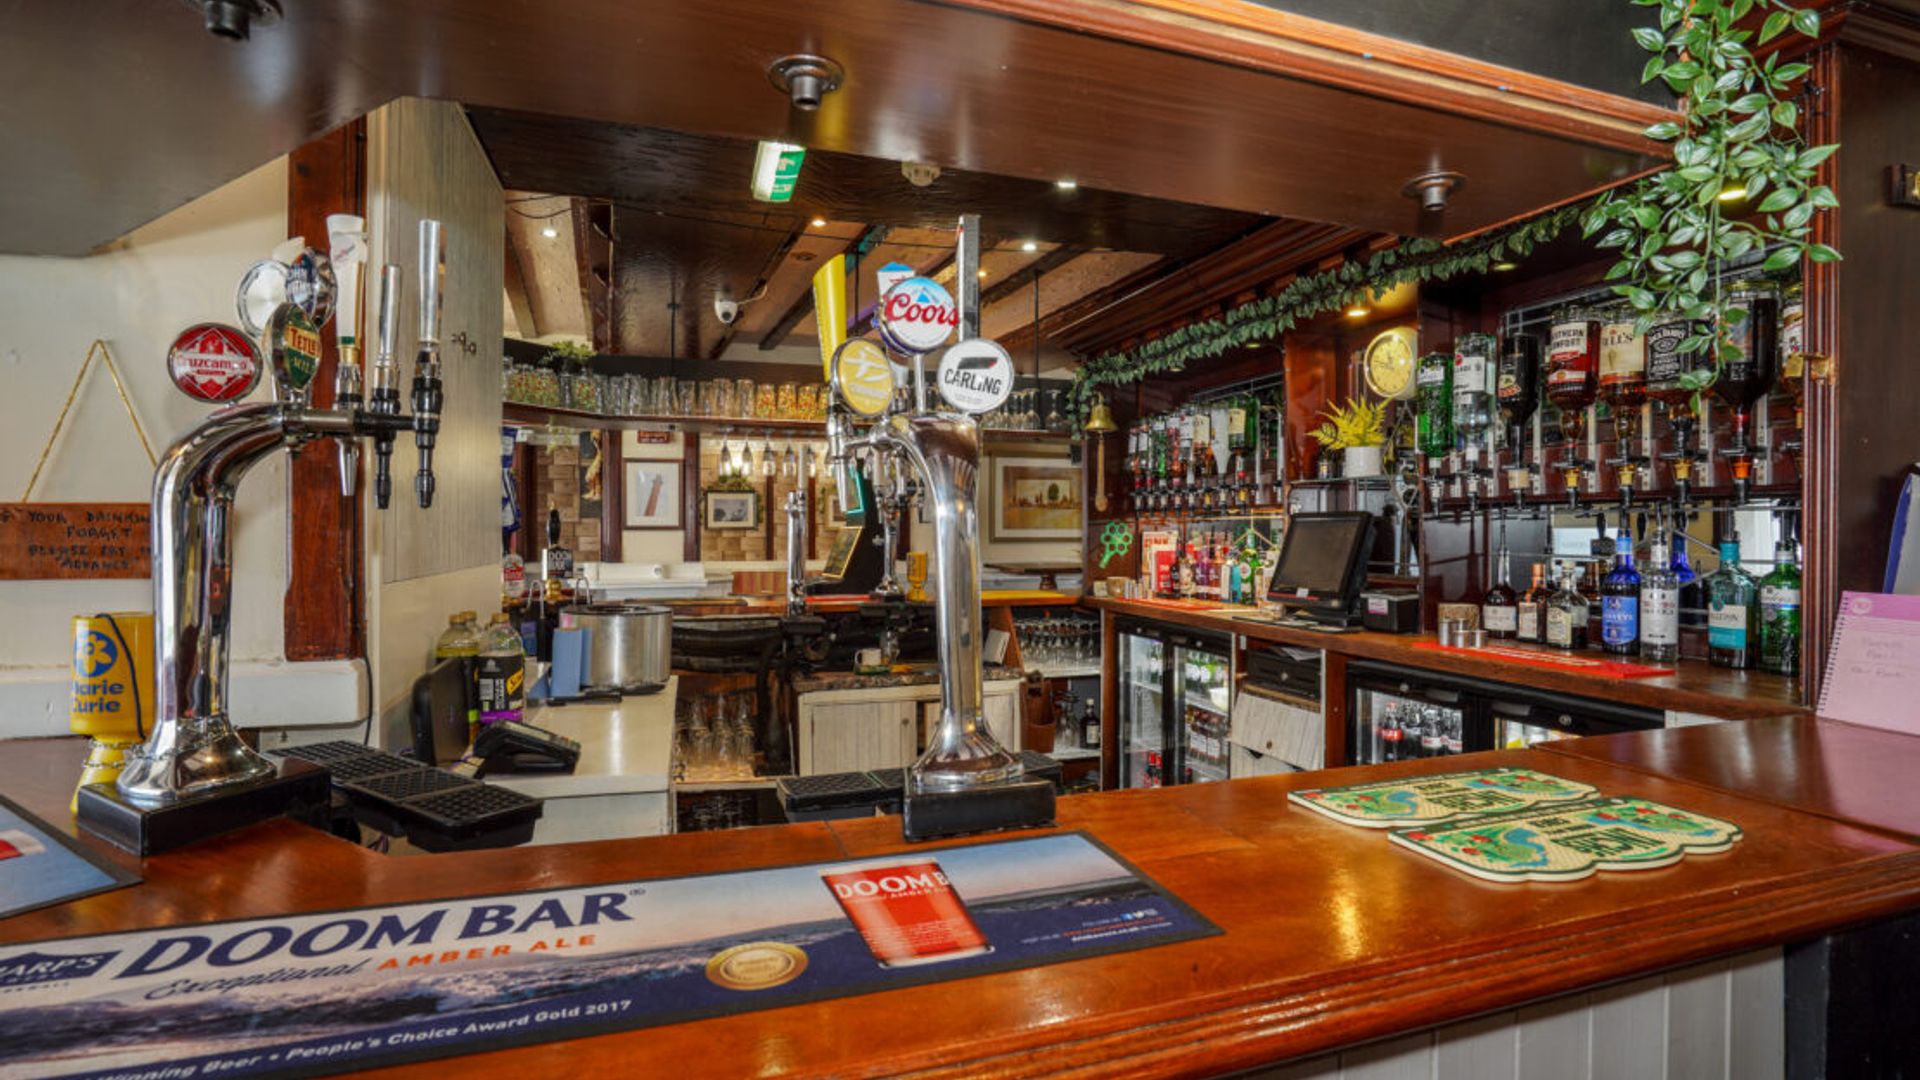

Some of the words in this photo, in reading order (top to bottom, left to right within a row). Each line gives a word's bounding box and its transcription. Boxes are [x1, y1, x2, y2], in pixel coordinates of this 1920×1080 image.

[884, 293, 960, 326] Coors
[944, 369, 1002, 395] CARLING
[834, 873, 930, 900] DOOM
[112, 908, 450, 980] DOOM
[144, 957, 372, 1000] Exceptional
[376, 944, 511, 972] AMBER
[529, 934, 596, 952] ALE
[203, 1055, 262, 1073] Beer
[286, 1037, 382, 1060] People's
[388, 1028, 459, 1047] Choice
[463, 1014, 530, 1035] Award
[535, 1006, 580, 1023] Gold
[585, 999, 632, 1016] 2017
